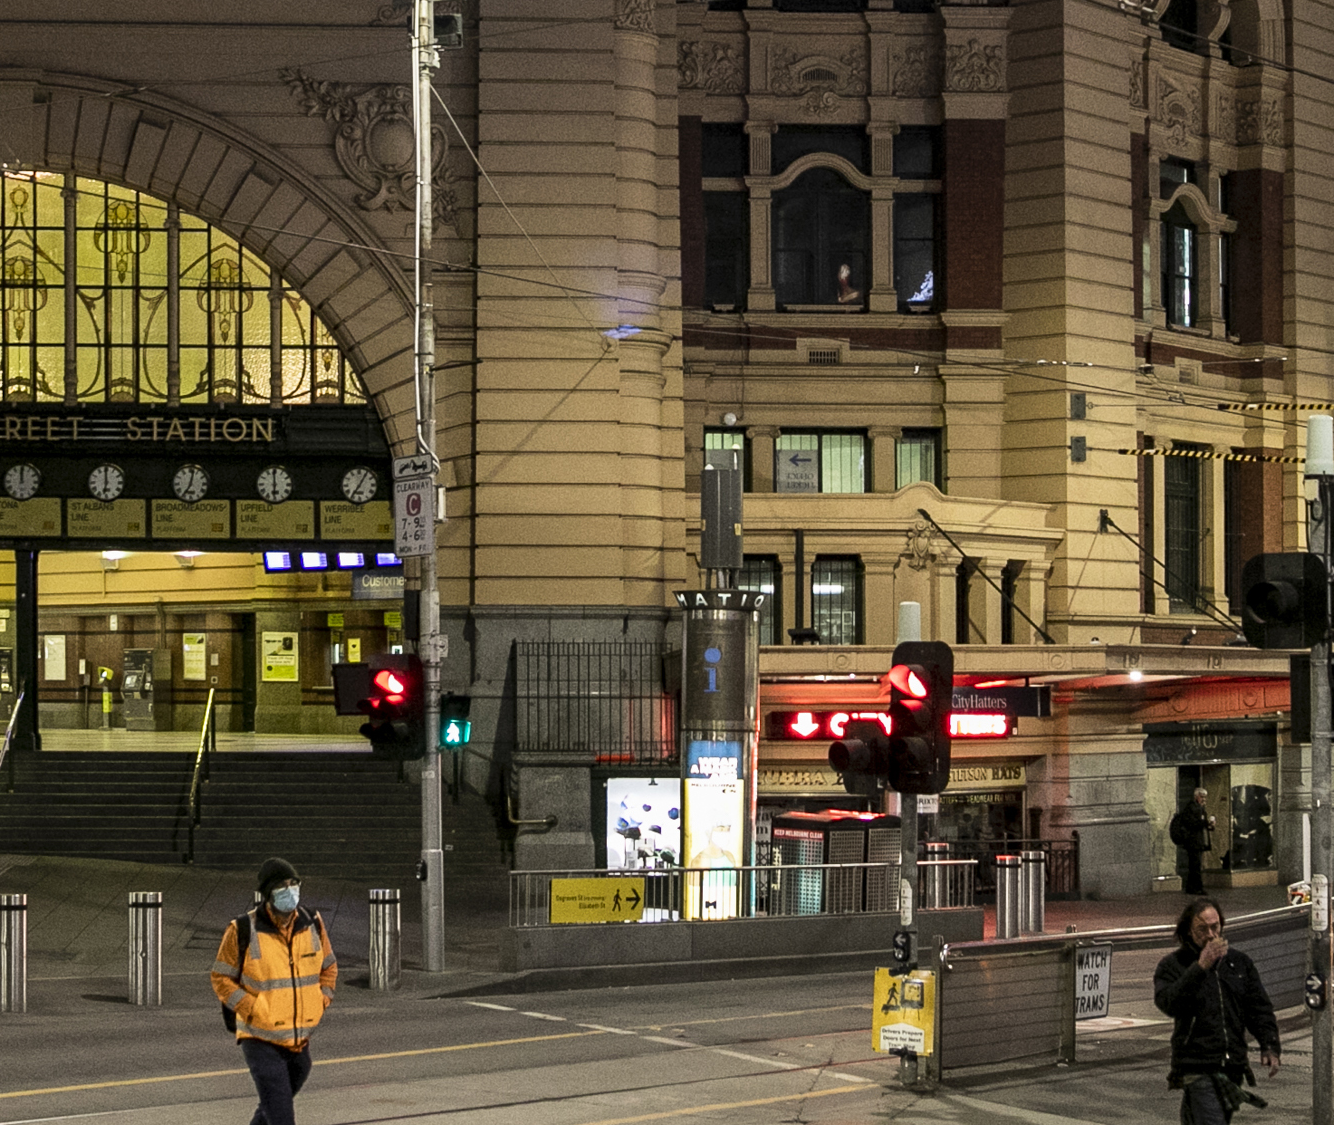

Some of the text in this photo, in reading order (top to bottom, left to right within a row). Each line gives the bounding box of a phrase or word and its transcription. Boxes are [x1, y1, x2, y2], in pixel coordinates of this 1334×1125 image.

[127, 416, 273, 443] STATION
[396, 479, 430, 493] CLEARWAY
[71, 502, 115, 511] ST ALBANS
[155, 503, 224, 512] BROADMEADOWS
[240, 504, 273, 512] UPFIELD
[324, 504, 365, 513] WERRIBEE
[408, 495, 418, 515] C
[71, 513, 89, 521] LINE
[155, 514, 173, 523] LINE
[240, 515, 258, 523] LINE
[324, 515, 342, 524] LINE
[398, 546, 412, 554] MON
[362, 573, 407, 588] Custome
[829, 712, 892, 736] CY
[991, 765, 1021, 780] HATS
[774, 828, 823, 839] KEEP MELBOURNE CLEAN
[1078, 950, 1107, 970] WATCH
[1082, 973, 1100, 991] FOR
[1075, 994, 1105, 1013] TRAMS
[902, 1028, 923, 1036] Prepare
